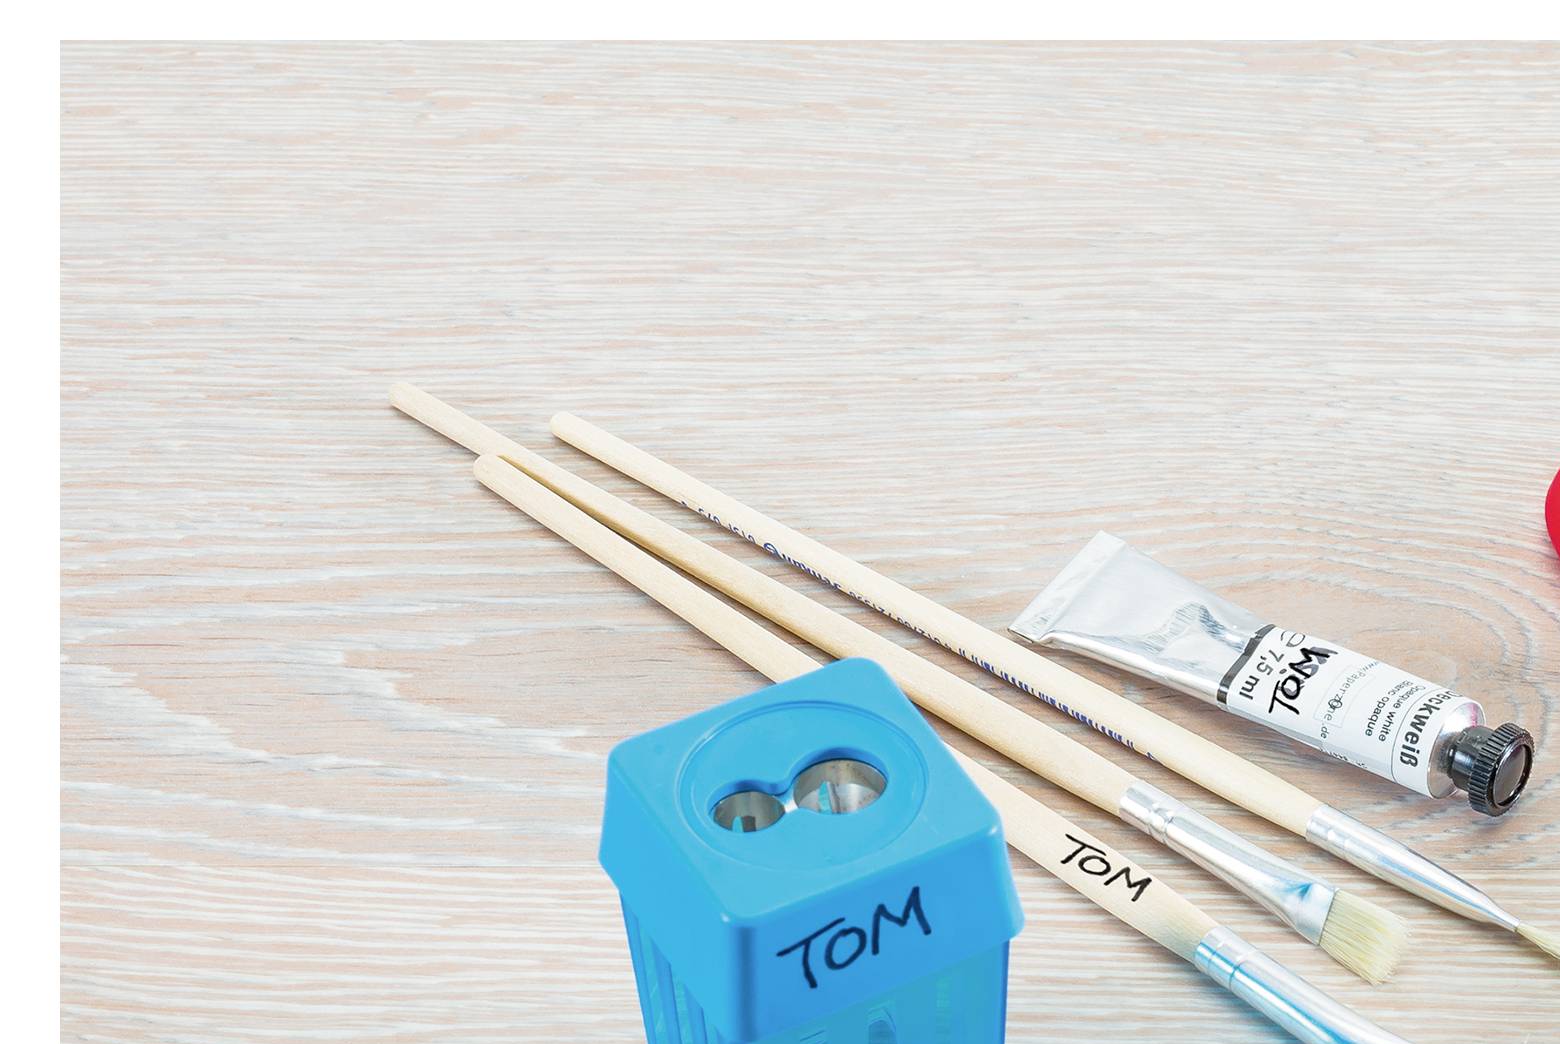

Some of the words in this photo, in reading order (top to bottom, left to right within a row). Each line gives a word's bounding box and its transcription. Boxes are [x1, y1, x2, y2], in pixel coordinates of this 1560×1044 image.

[1257, 650, 1285, 676] 7,5
[1239, 675, 1260, 700] ml
[1268, 648, 1330, 715] TOM
[1387, 680, 1414, 697] Blanc
[1391, 685, 1426, 710] Opaque
[1364, 696, 1390, 737] opaque
[1378, 710, 1398, 742] white
[1058, 833, 1153, 903] TOM
[776, 886, 932, 989] TOM
